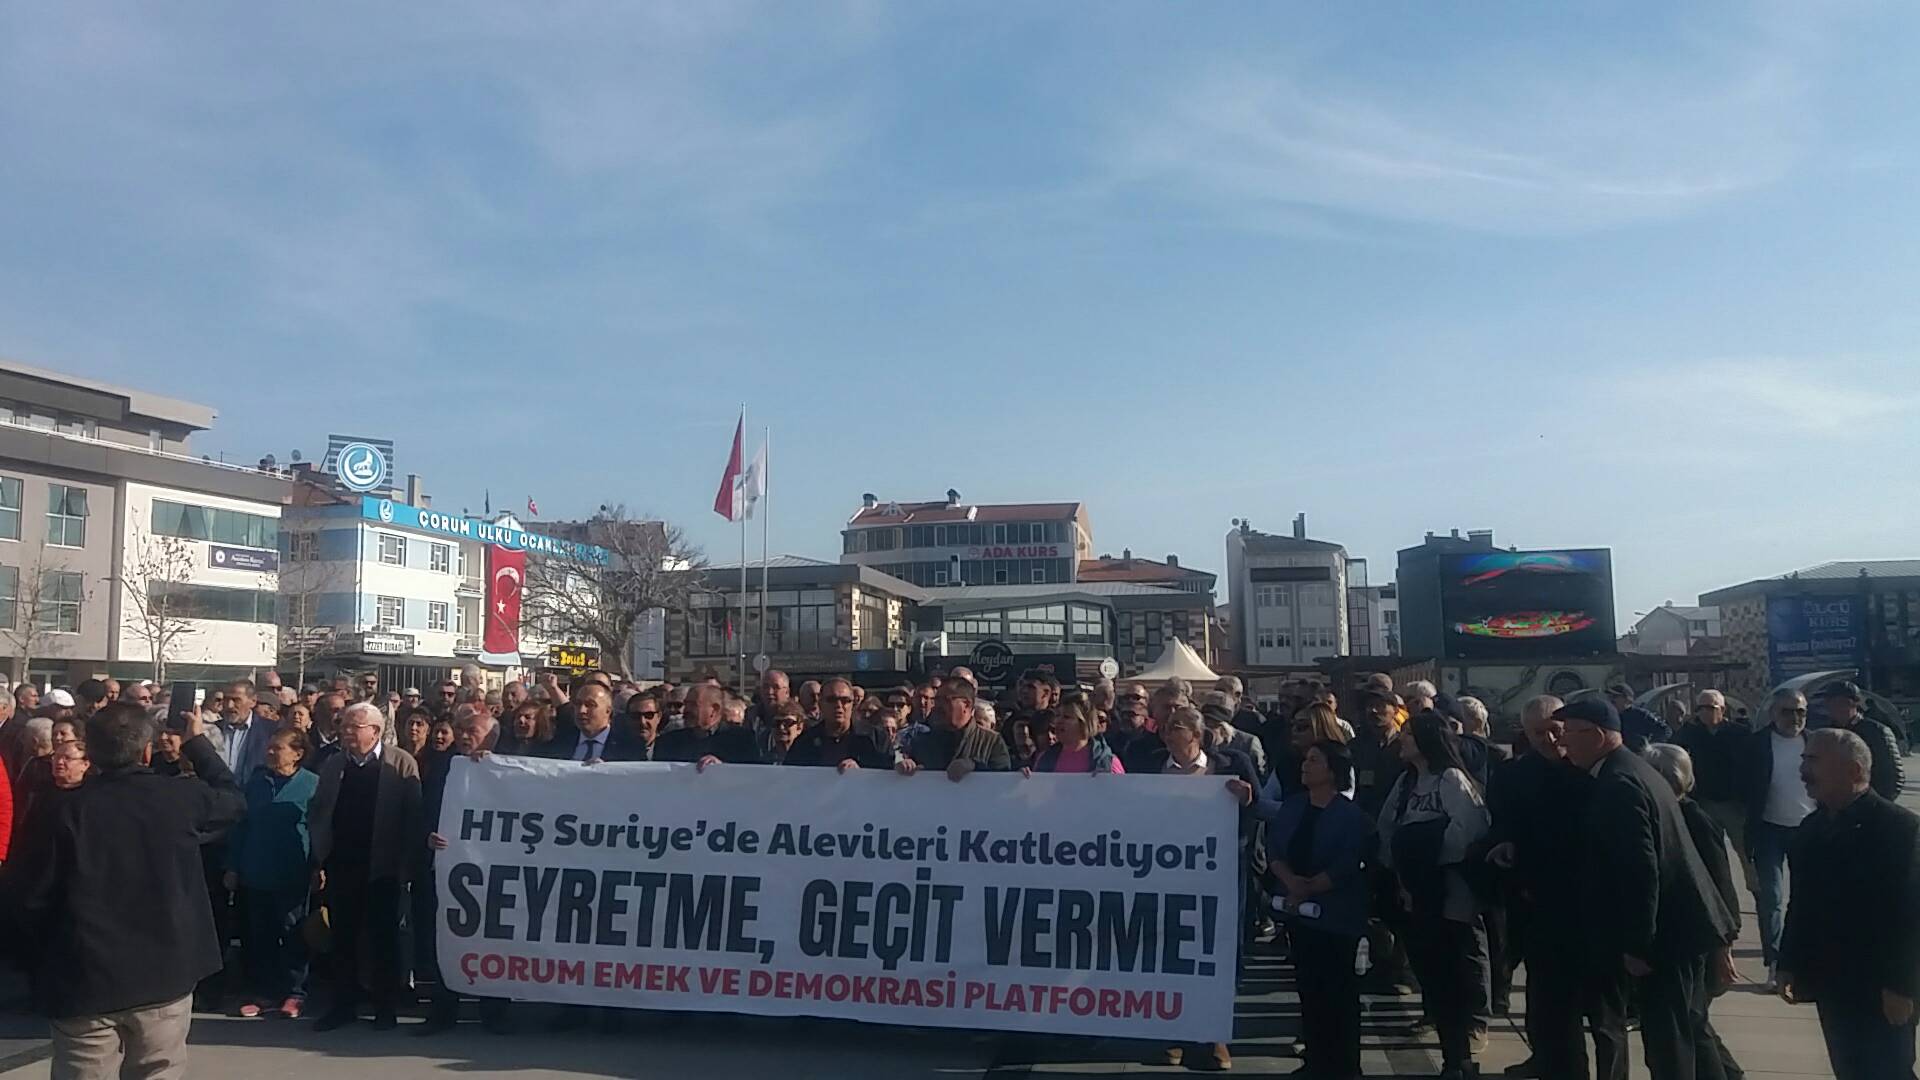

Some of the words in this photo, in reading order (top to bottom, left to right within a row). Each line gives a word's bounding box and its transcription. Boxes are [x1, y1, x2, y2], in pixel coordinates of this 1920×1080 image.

[418, 511, 470, 535] ÇORUM
[982, 547, 1013, 558] ADA
[1017, 546, 1058, 557] KURS
[969, 652, 1014, 672] Meydan
[460, 809, 544, 854] HTŞ
[554, 813, 760, 859] Suriye’de
[767, 823, 948, 861] Alevileri
[958, 829, 1218, 878] Katlediyor!
[446, 862, 775, 964] SEYRETME,
[799, 867, 964, 970] GEÇİT
[984, 886, 1218, 977] VERME!
[460, 953, 586, 986] ÇORUM
[593, 961, 690, 993] EMEK
[697, 966, 742, 995] VE
[748, 970, 956, 1008] DEMOKRASİ
[964, 981, 1183, 1020] PLATFORMU
